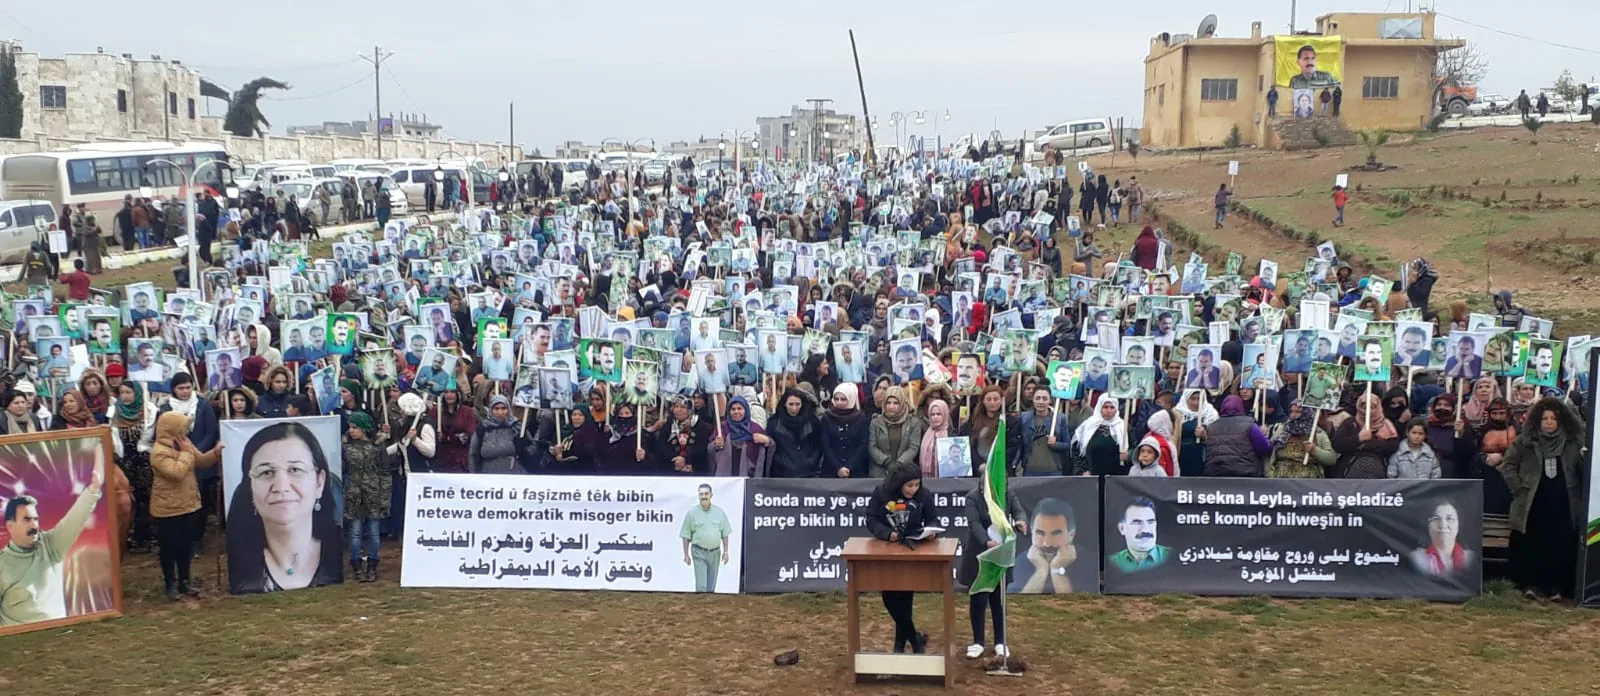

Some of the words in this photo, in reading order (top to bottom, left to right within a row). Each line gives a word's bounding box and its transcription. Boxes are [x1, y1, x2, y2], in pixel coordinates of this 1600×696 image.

[417, 486, 455, 501] ,Emê
[461, 487, 504, 500] tecrîd
[509, 488, 517, 500] û
[523, 488, 582, 504] faşîzmê
[587, 489, 611, 502] têk
[617, 490, 654, 503] bibin
[754, 493, 799, 507] Sonda
[804, 496, 825, 507] me
[830, 496, 848, 510] ye
[1177, 490, 1192, 504] Bi
[1198, 490, 1244, 505] sekna
[1250, 491, 1297, 509] Leyla,
[1302, 491, 1333, 506] rihê
[417, 507, 472, 519] netewa
[478, 507, 564, 521] demokratîk
[569, 508, 631, 525] misoger
[636, 509, 673, 523] bikin
[754, 515, 796, 530] parçe
[800, 513, 836, 527] bikin
[840, 513, 853, 527] bi
[1176, 511, 1210, 525] emê
[1215, 511, 1272, 529] komplo
[1276, 512, 1343, 530] hilweşîn
[1348, 513, 1362, 527] in
[416, 529, 475, 552] الفاشية
[481, 531, 534, 554] ونهزم
[540, 531, 589, 554] العزلة
[593, 532, 653, 555] سنكسر
[1179, 546, 1233, 565] شيلادزي
[1236, 546, 1280, 564] مقاومة
[1285, 549, 1315, 564] وروح
[1319, 548, 1350, 565] ليلى
[1354, 549, 1400, 566] بشموخ
[459, 557, 555, 581] الديمقراطية
[561, 556, 599, 578] الأمة
[605, 560, 653, 583] ونحقق
[1288, 567, 1336, 583] سنفشل
